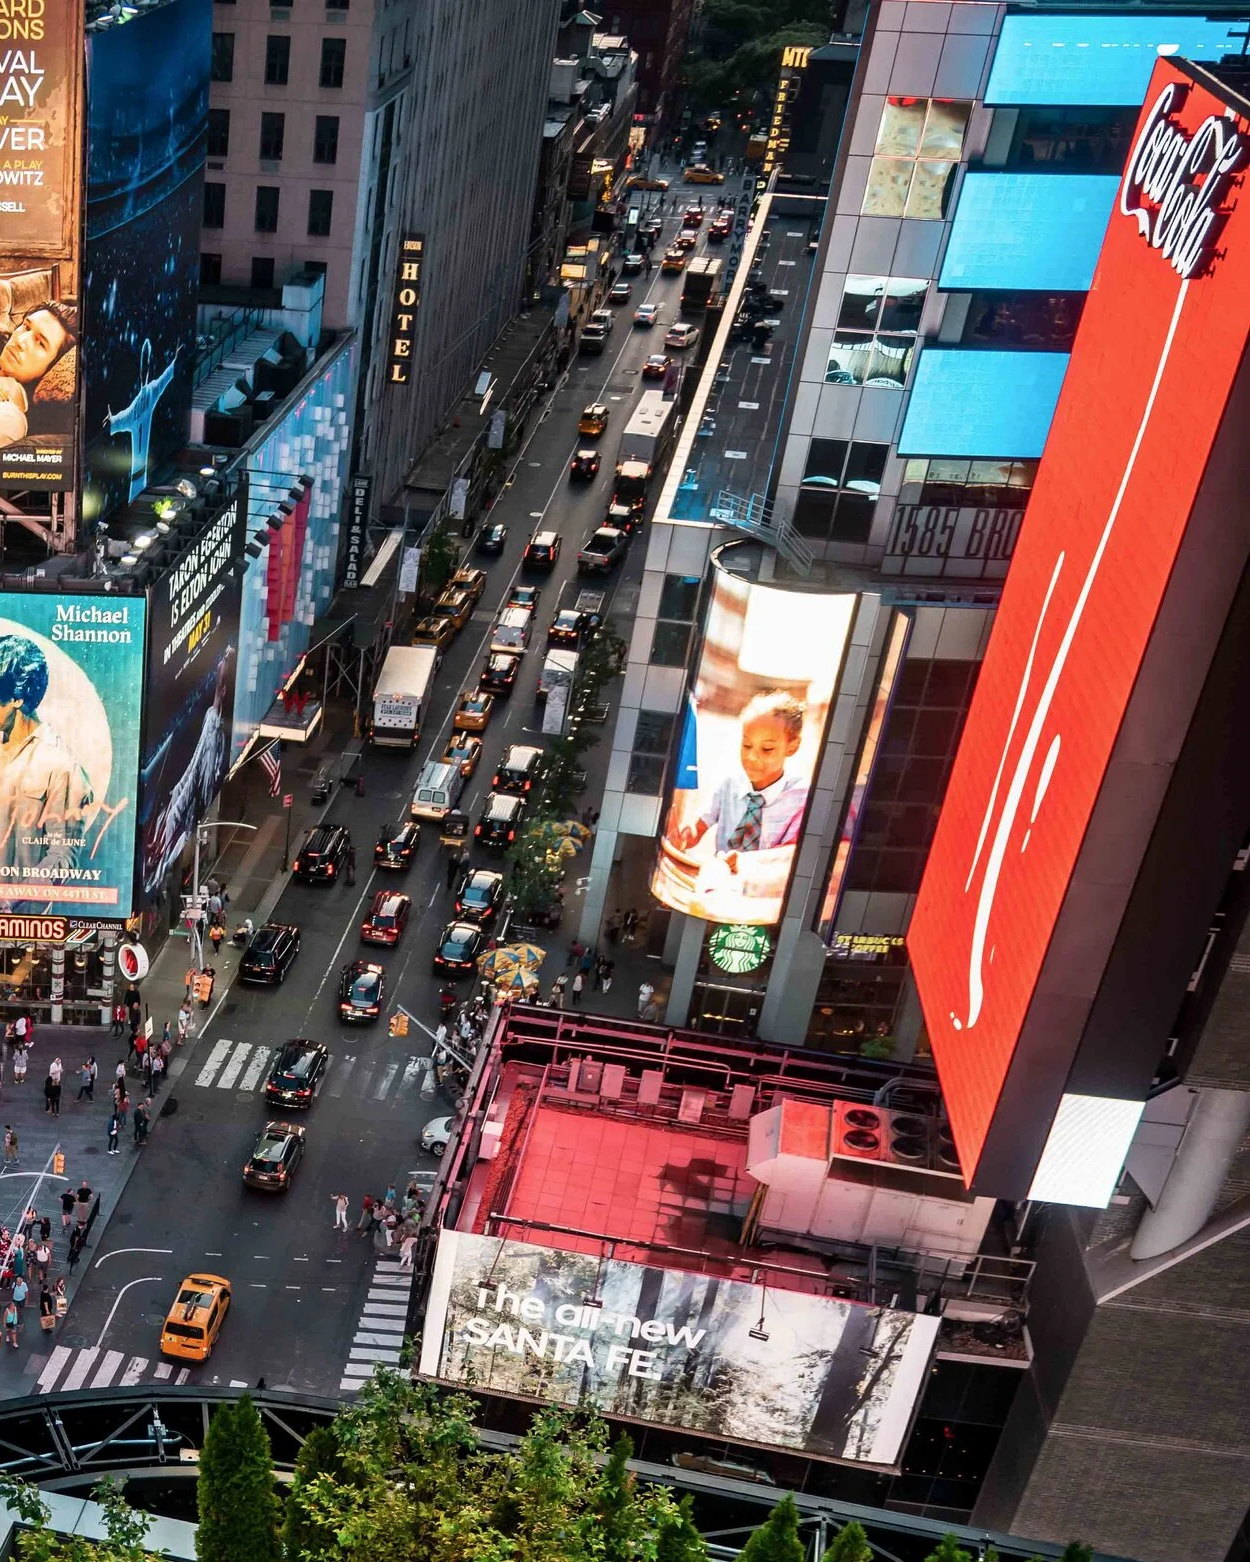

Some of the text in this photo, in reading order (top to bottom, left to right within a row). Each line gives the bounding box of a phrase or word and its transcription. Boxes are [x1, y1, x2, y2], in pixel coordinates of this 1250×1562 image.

[763, 79, 790, 172] FRIEDMAN
[2, 160, 12, 169] A
[14, 160, 44, 170] PLAY
[1120, 83, 1242, 279] Coca-Cola
[391, 262, 420, 381] HOTEL
[2, 453, 62, 464] MICHAEL MAYER
[2, 472, 62, 481] BURNTHISPLAY.COM
[891, 506, 960, 555] 1585
[169, 545, 199, 601] TARON
[200, 500, 238, 563] EGERTON
[170, 599, 180, 628] IS
[180, 567, 209, 617] ELTON
[208, 534, 232, 582] JOHN
[56, 604, 129, 624] Michael
[51, 625, 133, 644] Shannon
[188, 620, 203, 654] MAY
[21, 837, 86, 848] CLAIR LUNE
[1, 865, 20, 878] ON
[22, 867, 102, 882] BROADWAY
[6, 887, 40, 898] AWAY
[42, 889, 60, 899] ON
[62, 889, 91, 900] 44TH
[477, 1280, 707, 1349] The all-new
[462, 1317, 662, 1381] SANTA FE
